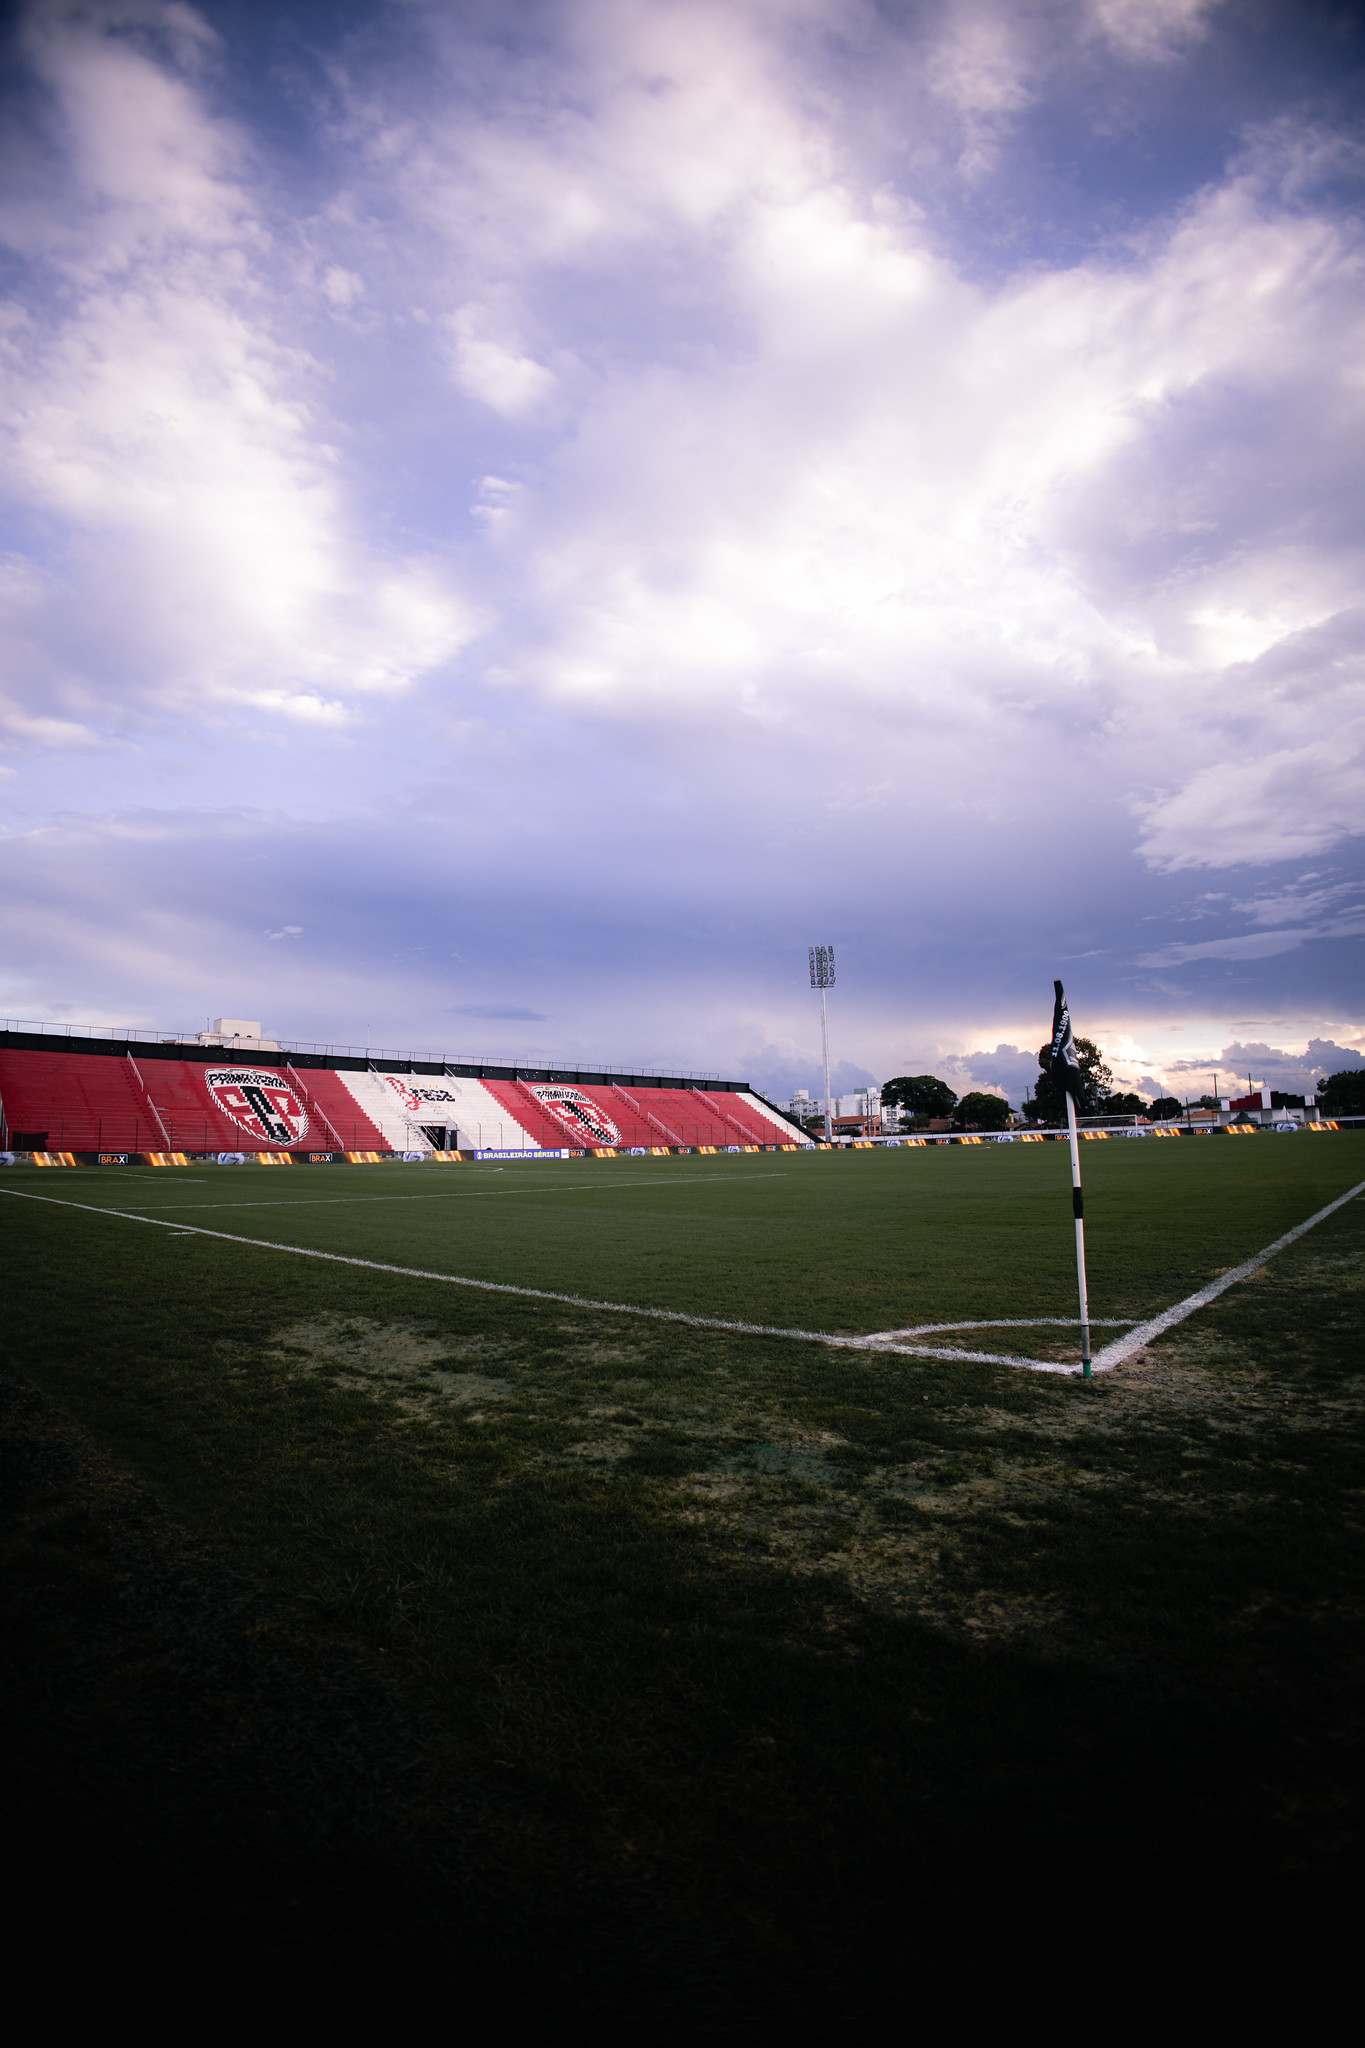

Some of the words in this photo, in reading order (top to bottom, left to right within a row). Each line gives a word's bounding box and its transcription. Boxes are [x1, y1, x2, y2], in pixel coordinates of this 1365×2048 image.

[1052, 1010, 1069, 1058] 11.08.1900
[311, 1154, 331, 1162] BRAX
[483, 1150, 533, 1159] BRASILEIRÃO
[533, 1150, 554, 1158] SÉRIE
